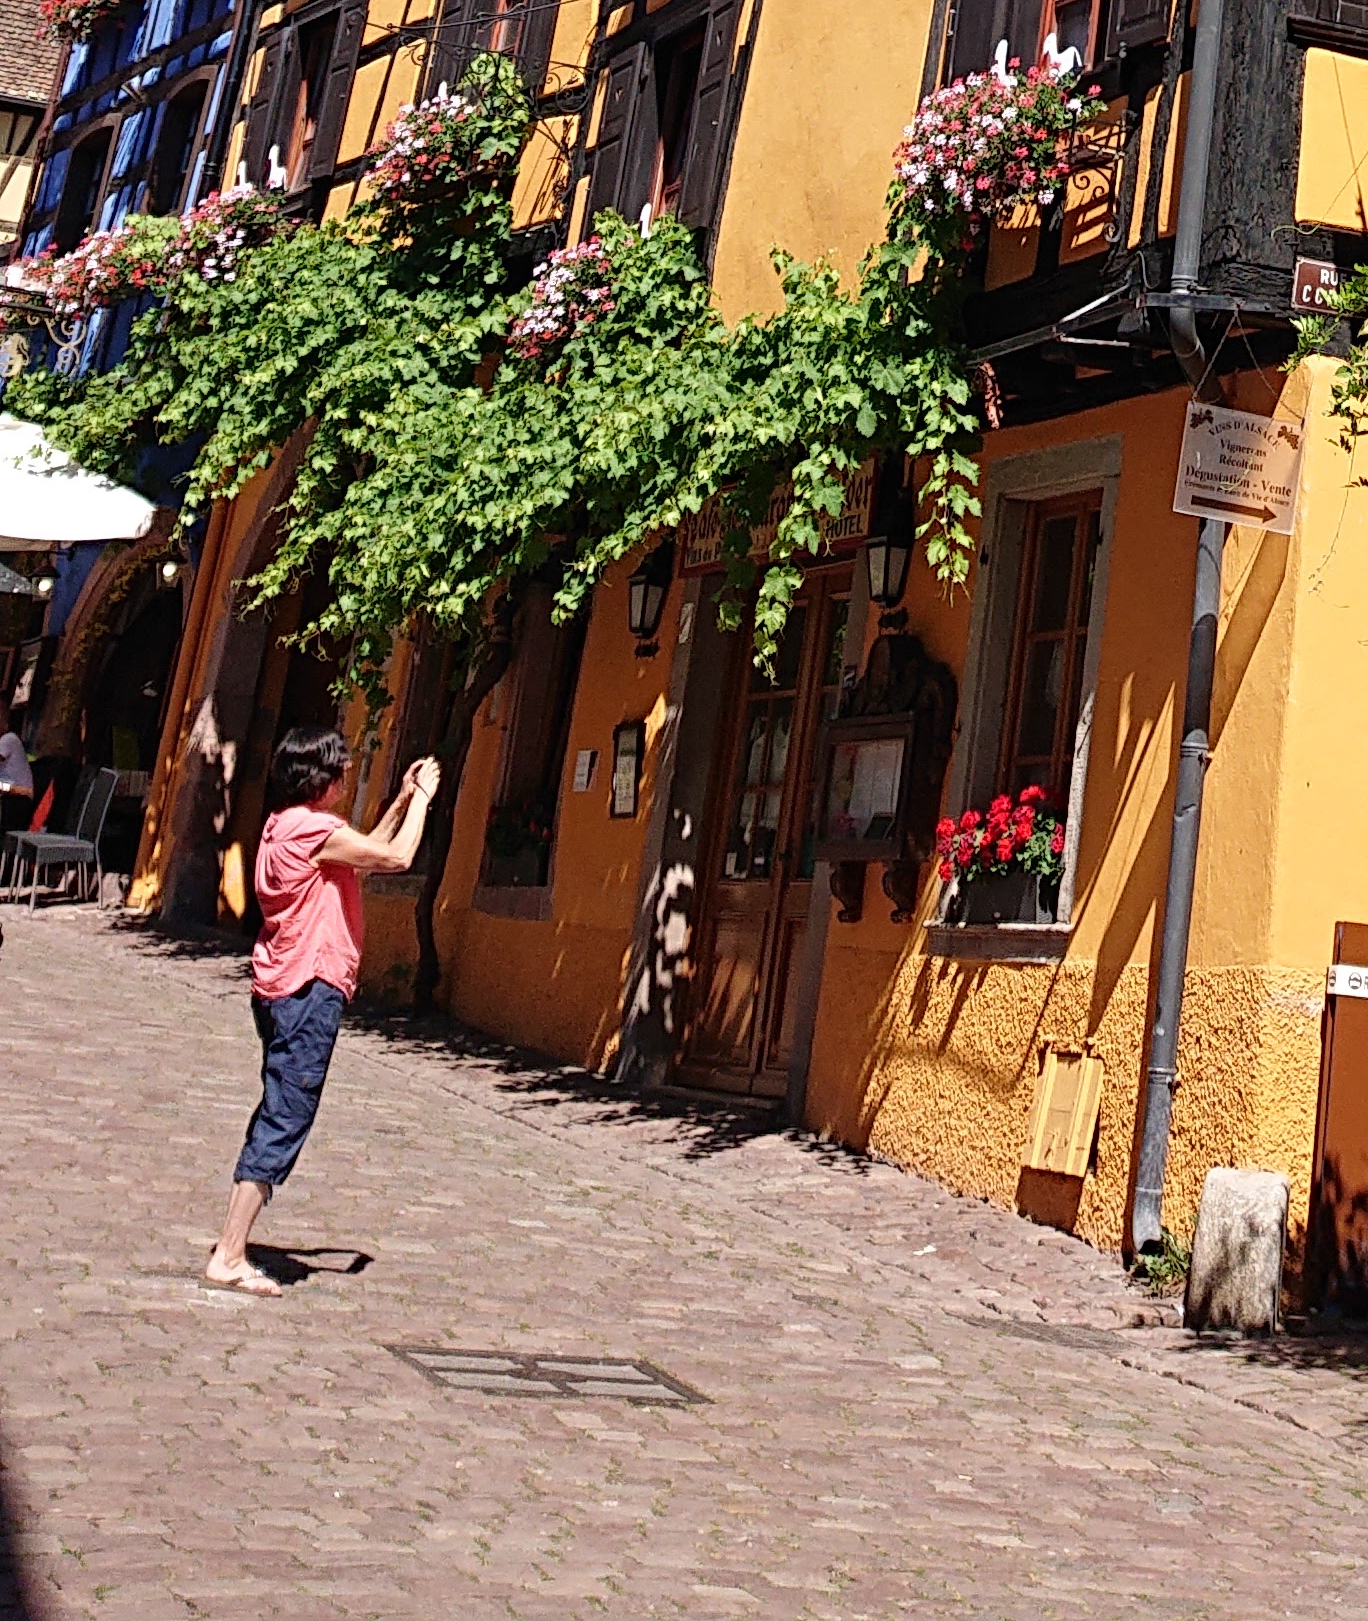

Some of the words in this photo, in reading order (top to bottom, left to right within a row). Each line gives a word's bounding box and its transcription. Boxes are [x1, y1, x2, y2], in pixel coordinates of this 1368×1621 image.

[1208, 421, 1232, 436] VINS
[1233, 421, 1280, 449] D'ALSACE
[1220, 438, 1267, 457] Vignerons
[1219, 454, 1264, 472] Récoltant
[1261, 480, 1292, 497] Vente
